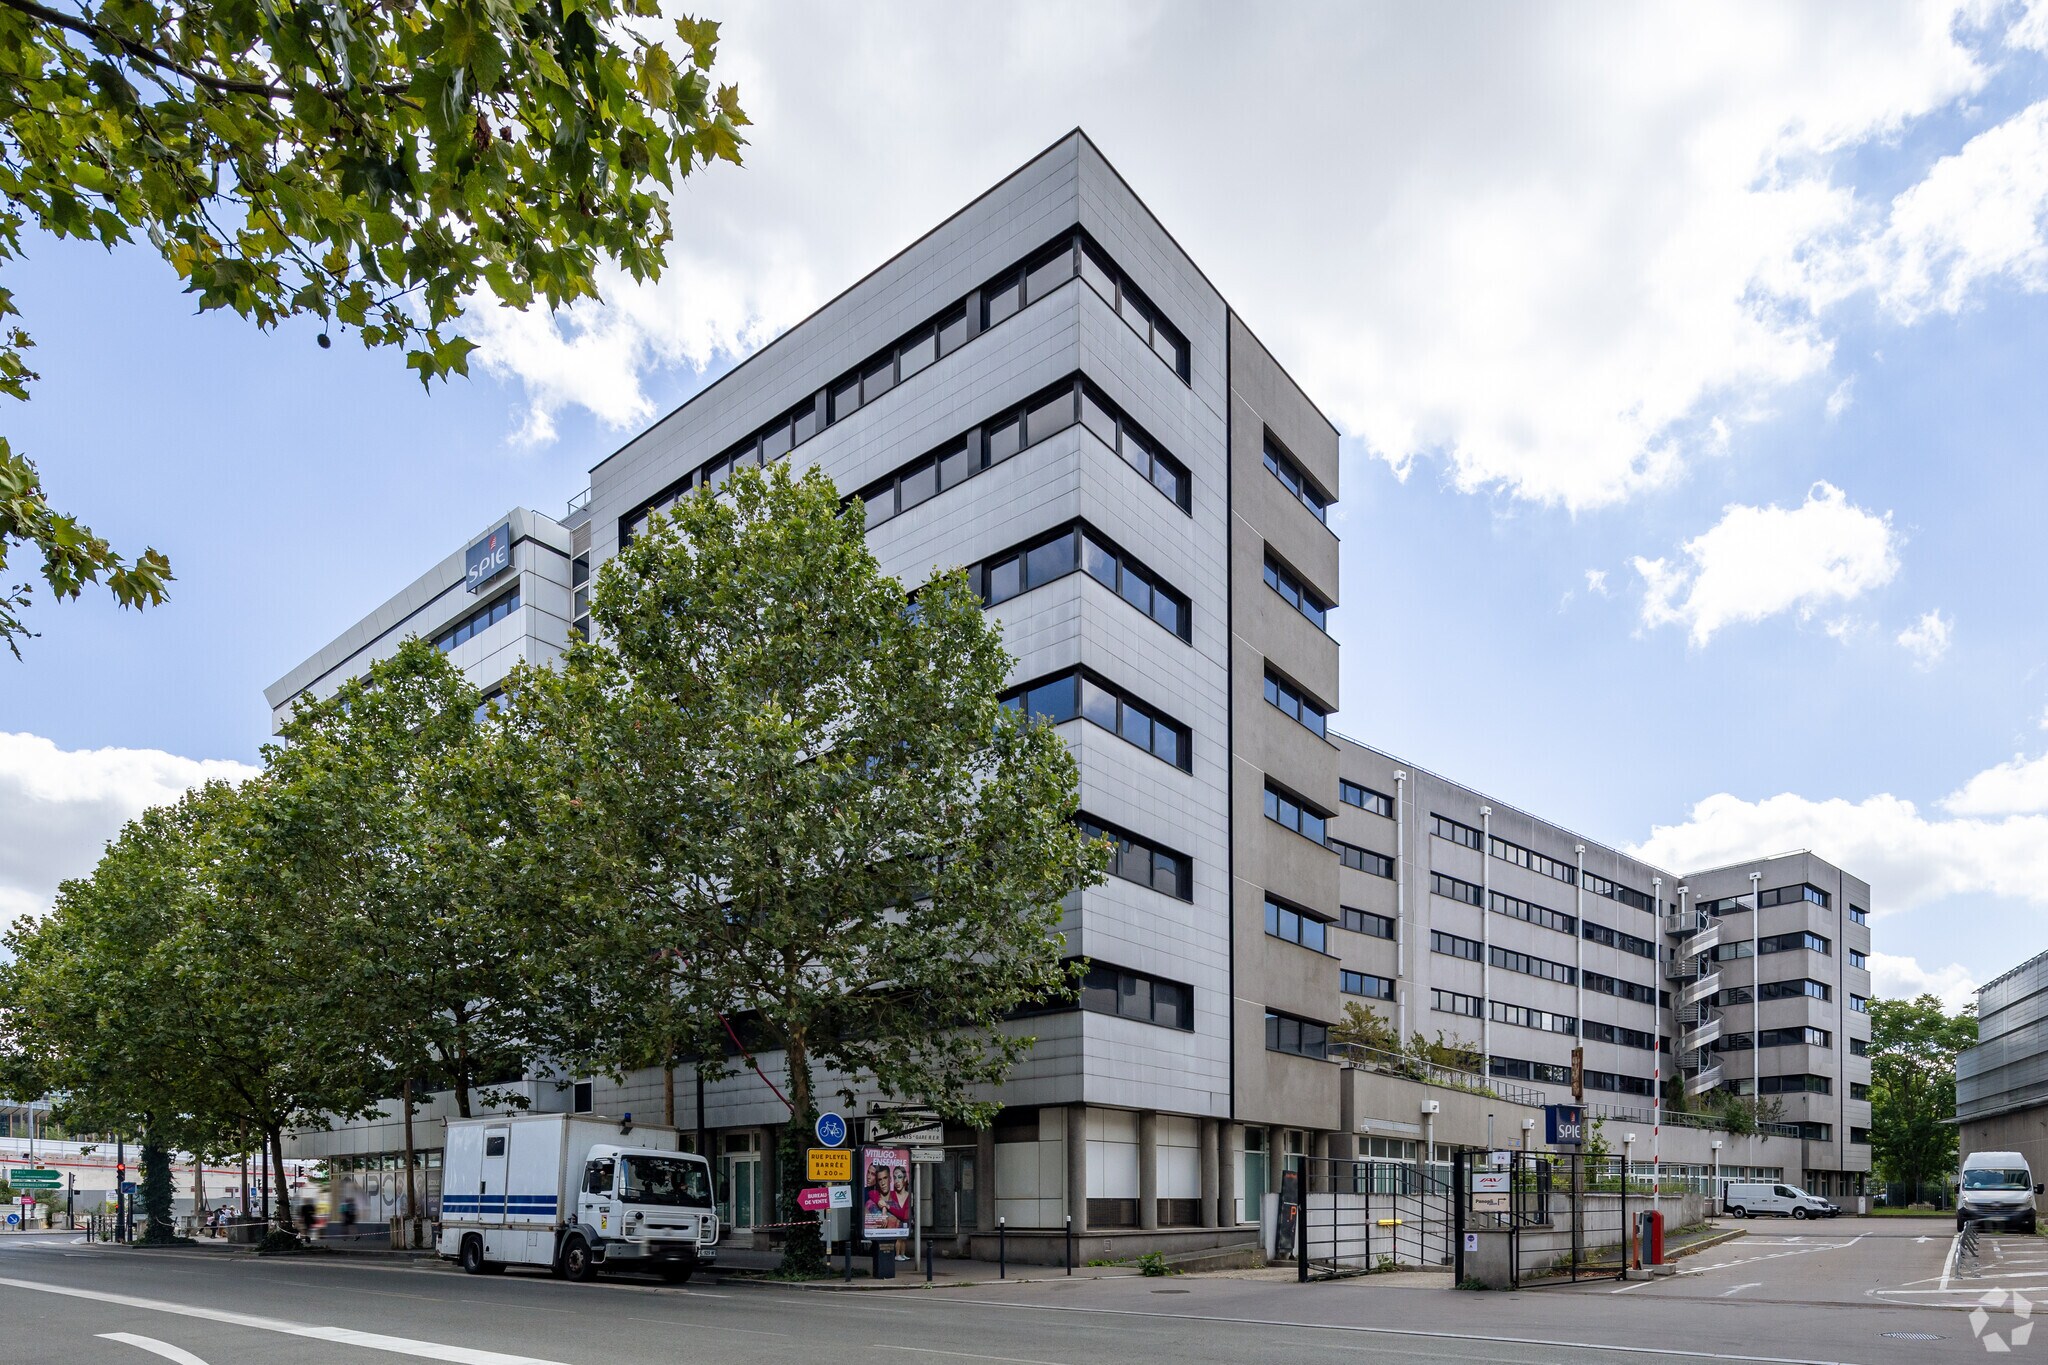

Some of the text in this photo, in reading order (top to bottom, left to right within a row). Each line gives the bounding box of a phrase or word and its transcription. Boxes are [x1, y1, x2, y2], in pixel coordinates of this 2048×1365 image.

[468, 545, 506, 584] SPIE
[1558, 1124, 1581, 1138] SPIE
[872, 1158, 907, 1167] ENSEMBLE
